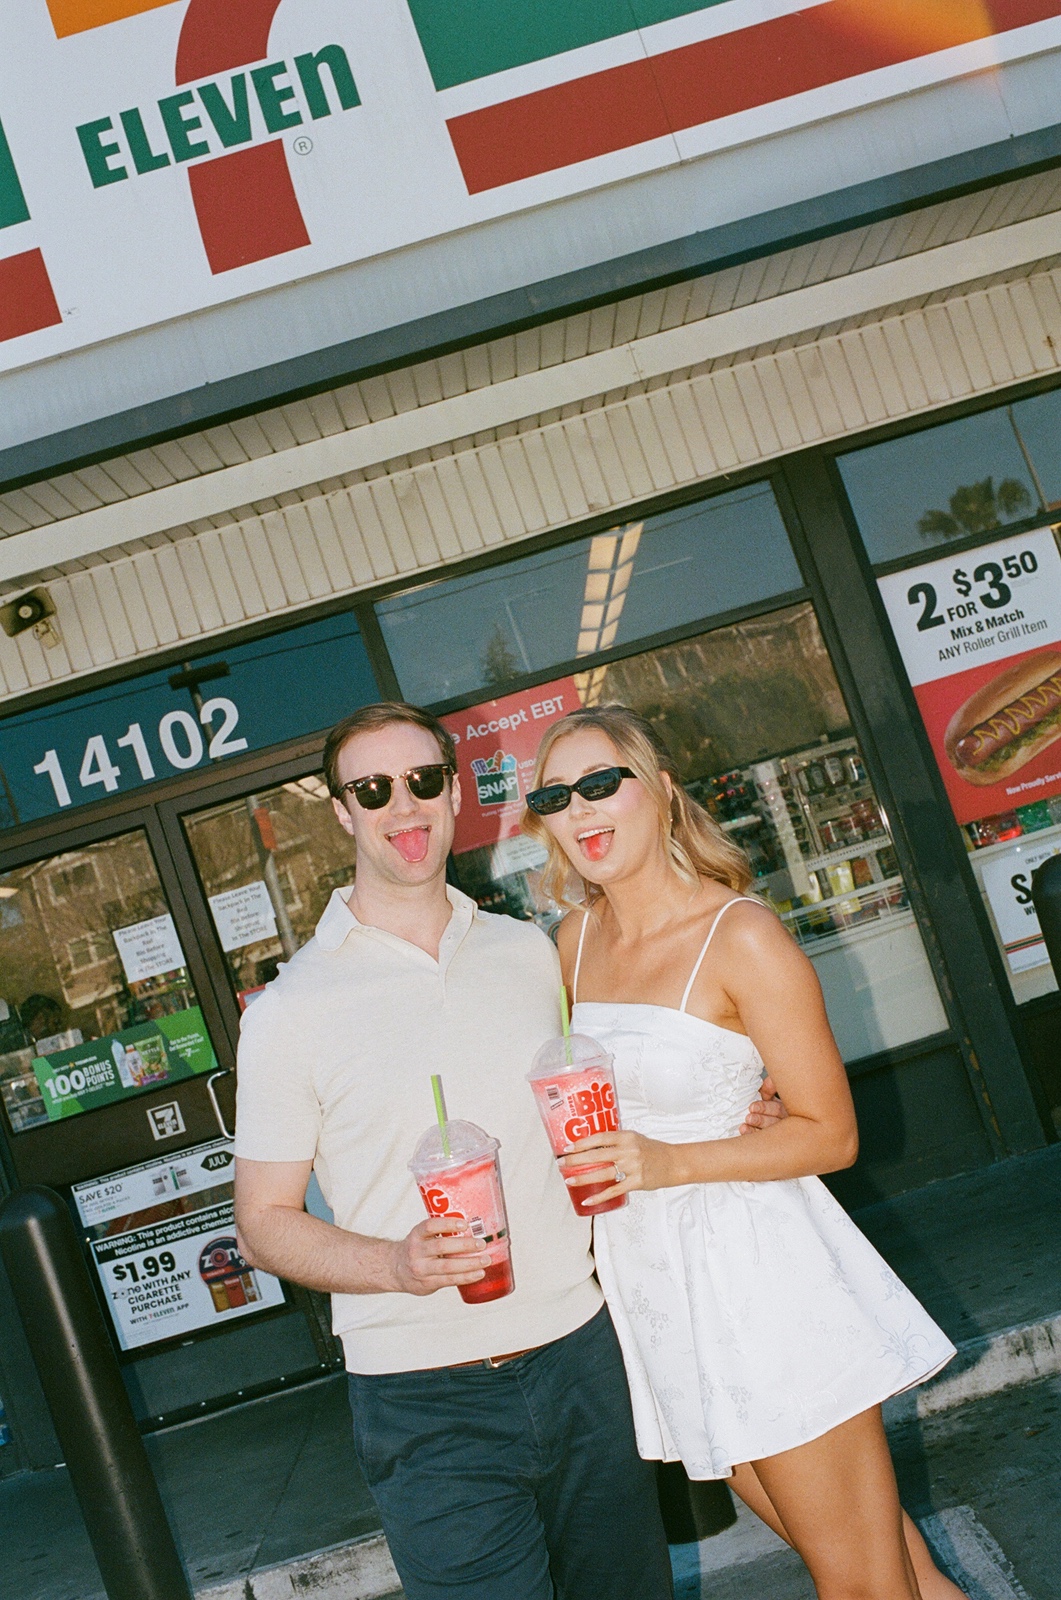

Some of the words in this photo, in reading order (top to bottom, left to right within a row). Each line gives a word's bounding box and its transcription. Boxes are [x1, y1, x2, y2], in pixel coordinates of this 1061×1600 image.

[907, 582, 946, 632] 2
[946, 601, 979, 622] FOR
[950, 624, 974, 641] Mix
[975, 620, 985, 633] &
[985, 609, 1025, 629] Match
[938, 644, 961, 662] ANY
[963, 634, 996, 654] Roller
[997, 624, 1021, 643] Grill
[1023, 618, 1048, 636] Item
[466, 709, 528, 741] Accept
[530, 695, 564, 720] EBT
[33, 697, 248, 808] 14102
[478, 775, 519, 800] SNAP
[82, 1059, 112, 1078] BONUS
[85, 1071, 115, 1087] POINTS
[44, 1070, 87, 1099] 100
[79, 1186, 103, 1204] SAVE
[96, 1235, 137, 1252] WARNING:
[137, 1230, 154, 1240] This
[155, 1221, 185, 1236] product
[185, 1211, 218, 1225] contains
[115, 1241, 146, 1256] Nicotine
[156, 1236, 165, 1244] an
[166, 1225, 200, 1240] addictive
[112, 1251, 176, 1284] $1.99
[143, 1278, 168, 1290] WITH
[169, 1271, 191, 1283] ANY
[128, 1284, 180, 1305] CIGARETTE
[131, 1293, 183, 1314] PURCHASE
[130, 1316, 147, 1324] WITH
[176, 1303, 189, 1311] APP
